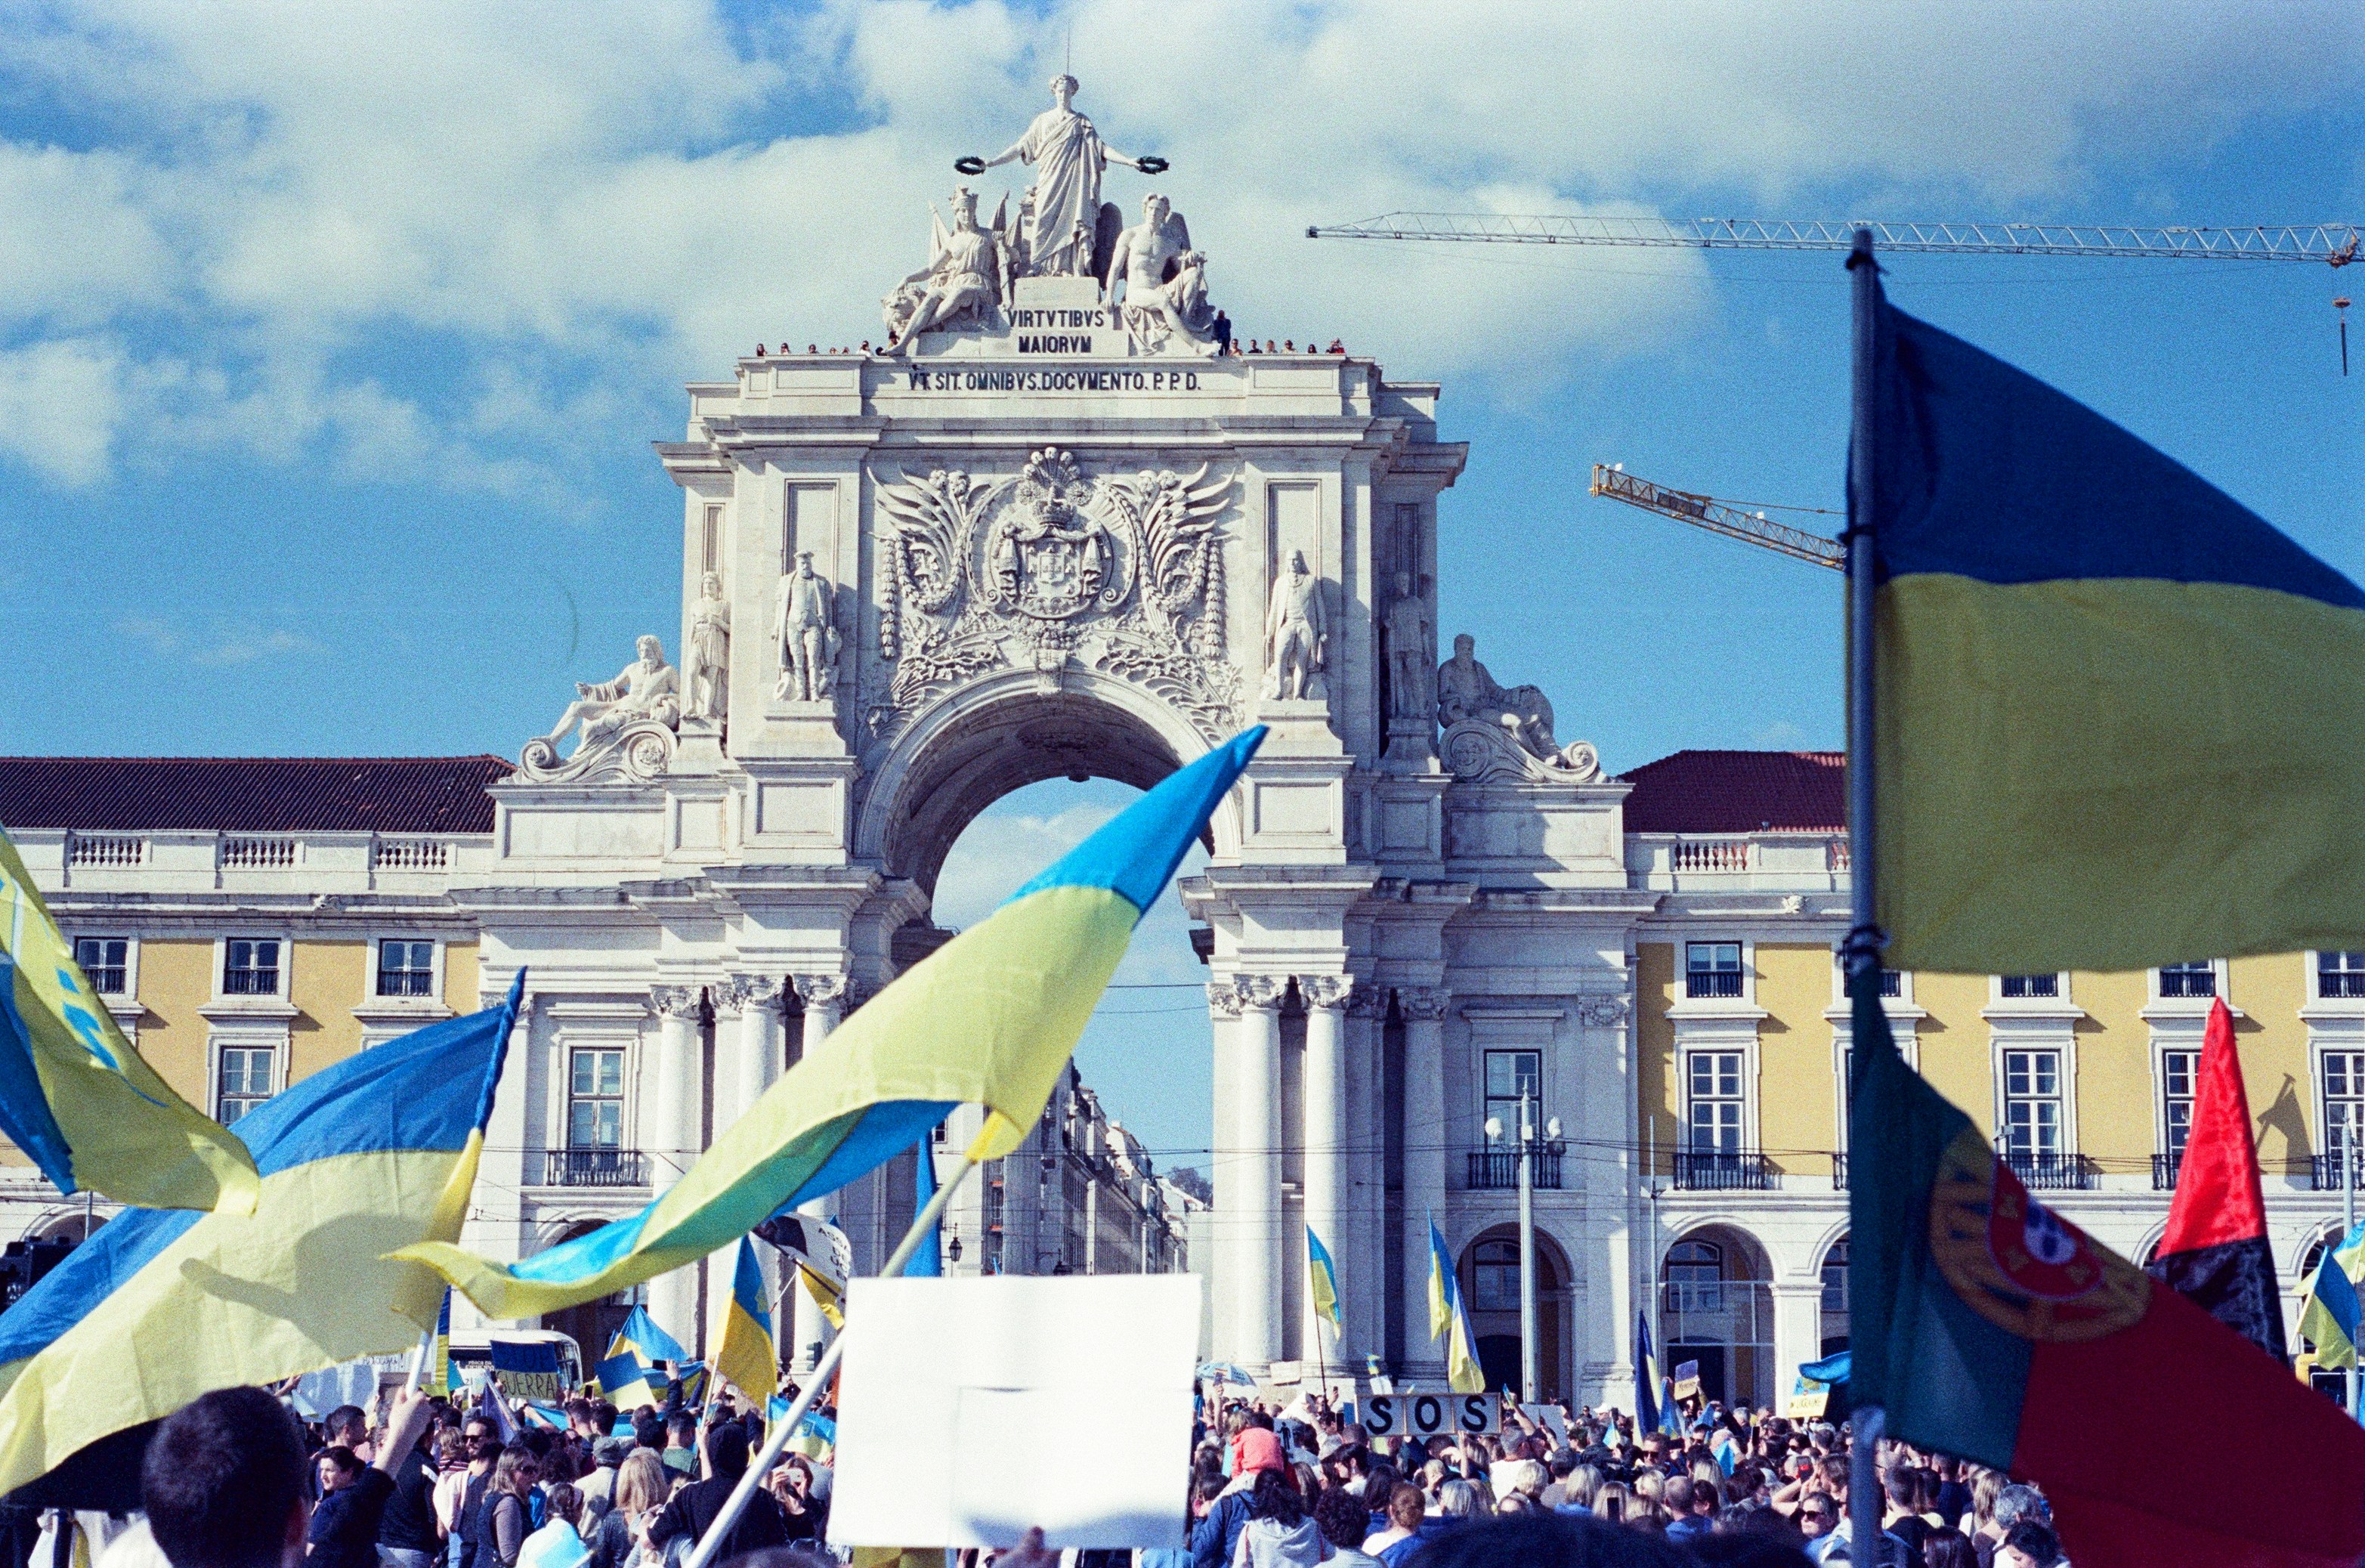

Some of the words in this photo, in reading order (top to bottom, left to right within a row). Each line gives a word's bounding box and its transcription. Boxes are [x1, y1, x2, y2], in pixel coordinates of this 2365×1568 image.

[1007, 310, 1104, 327] VIRTVTIBVS
[1019, 336, 1091, 353] MAIORVM
[1365, 1395, 1488, 1435] SOS
